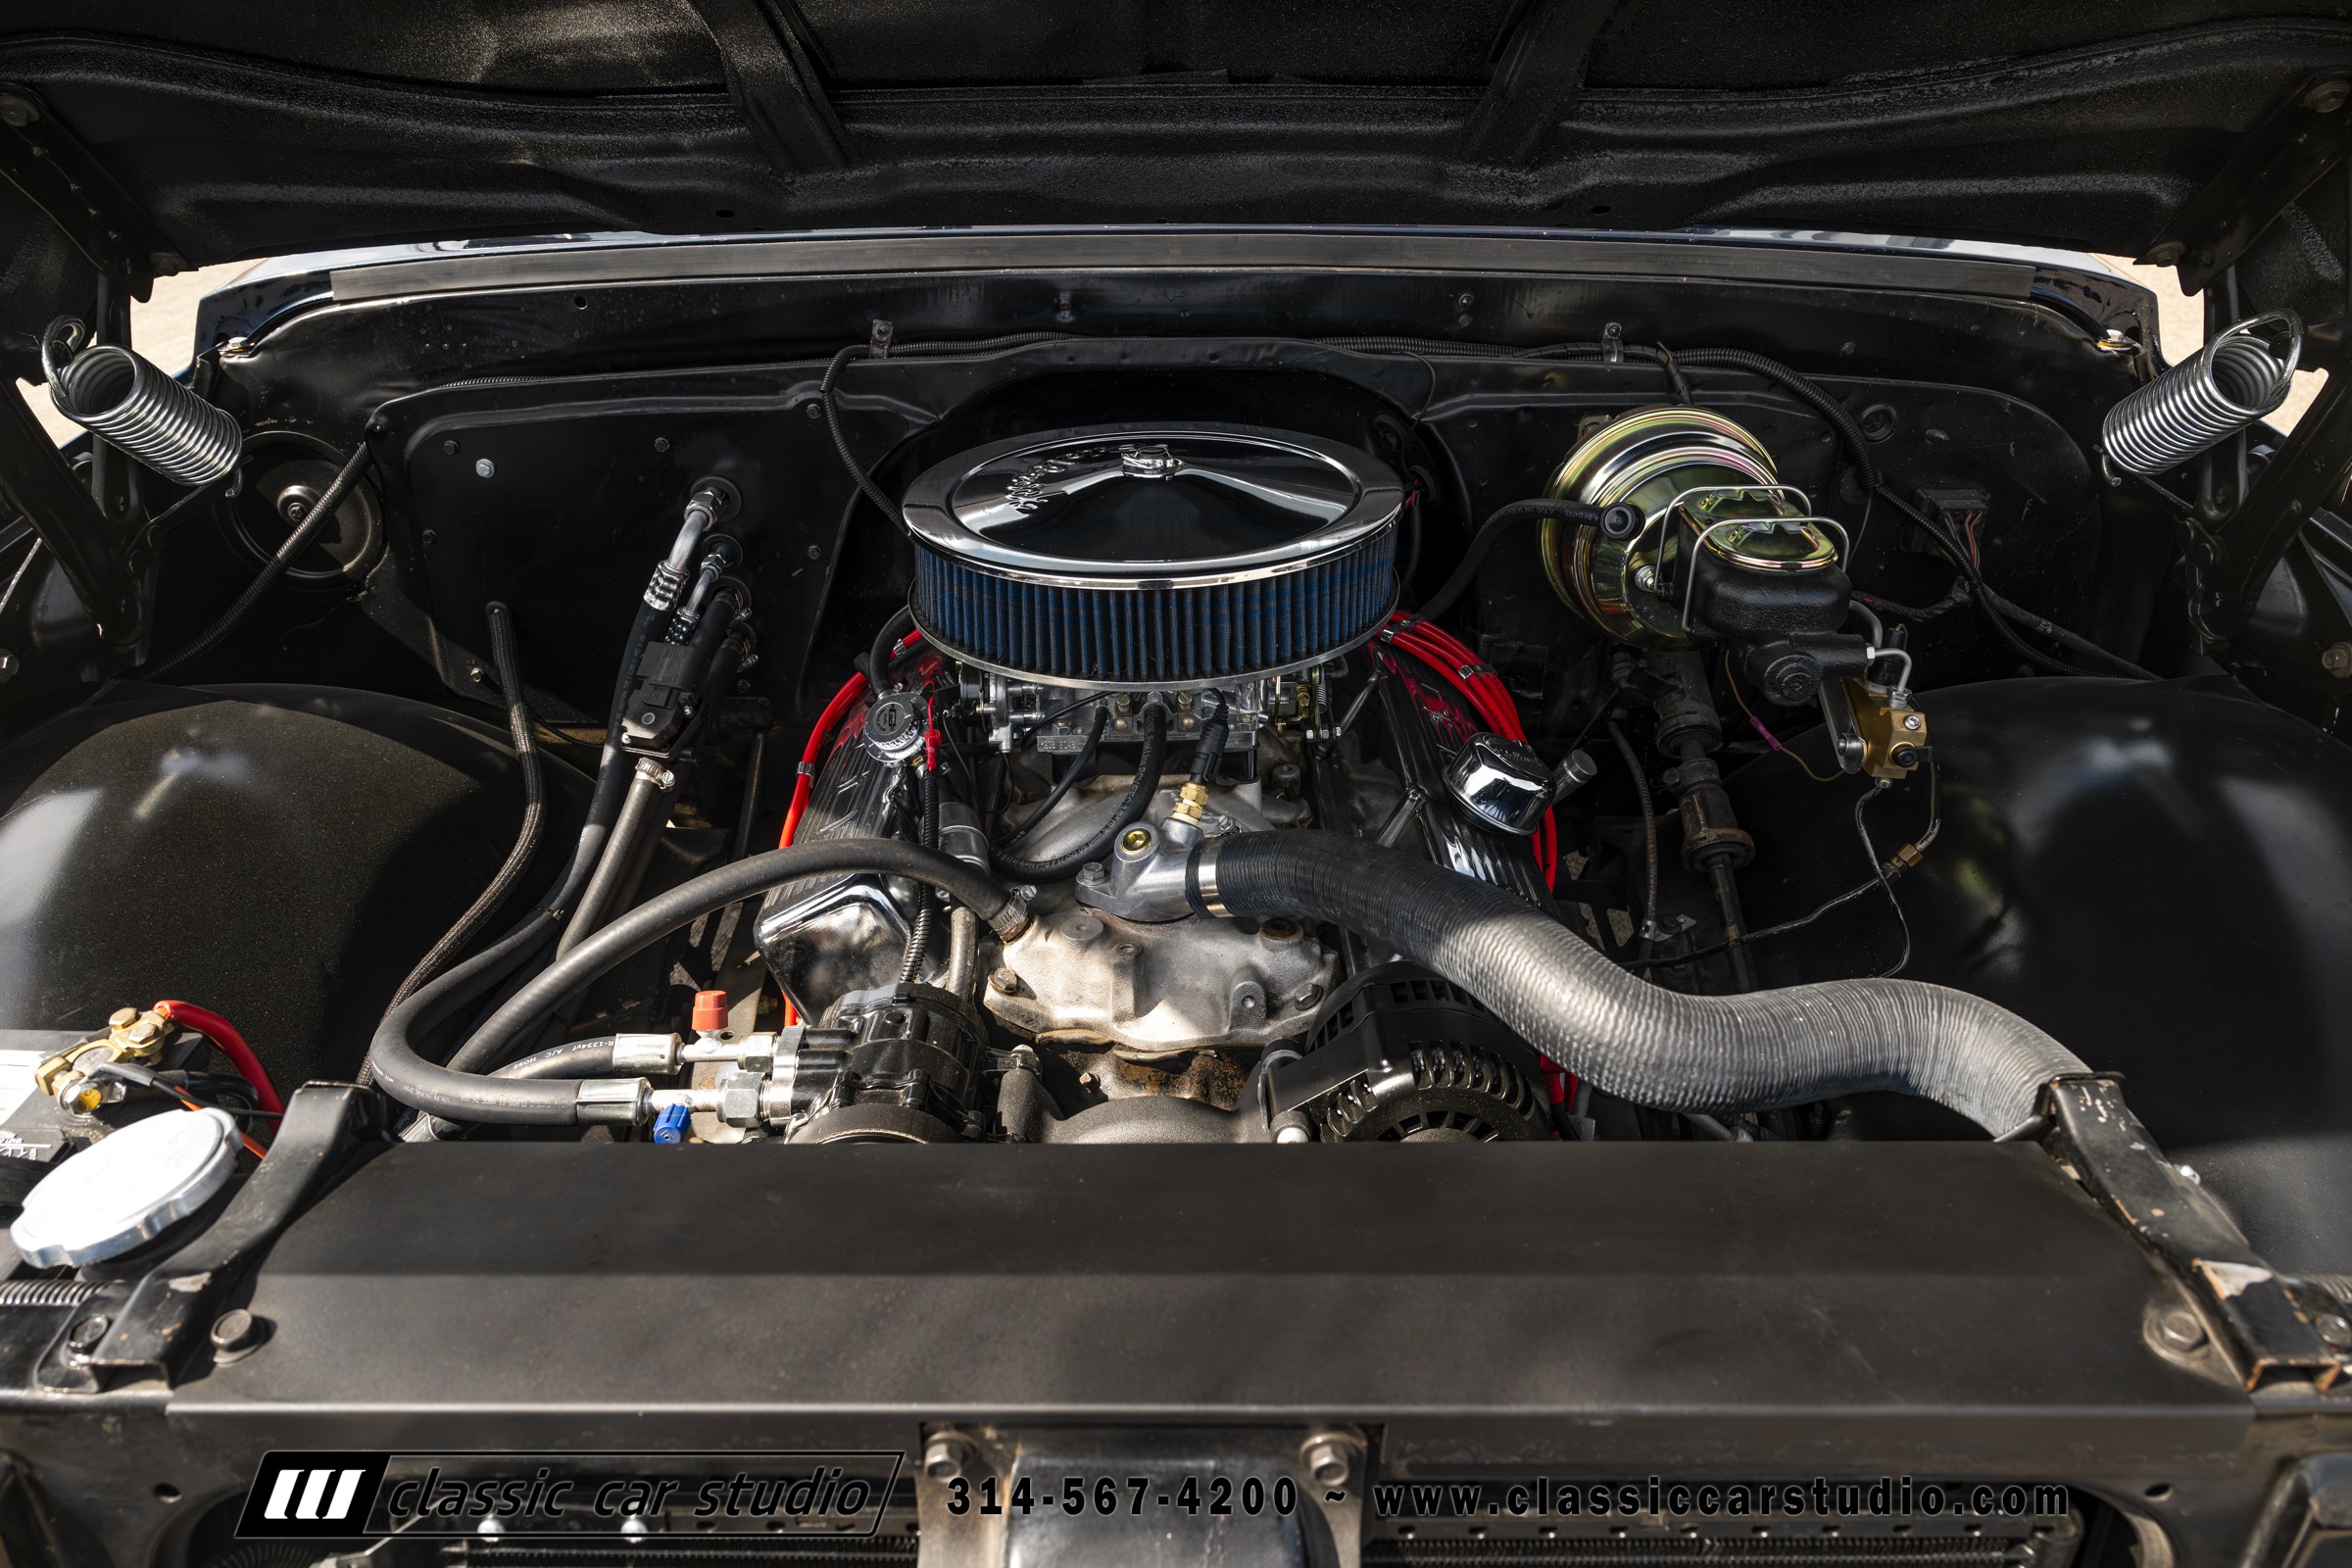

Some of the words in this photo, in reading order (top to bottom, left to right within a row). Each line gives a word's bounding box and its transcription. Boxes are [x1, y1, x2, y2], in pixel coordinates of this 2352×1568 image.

[1565, 509, 1584, 519] GATES
[571, 1040, 614, 1052] R-1234yf
[544, 1048, 564, 1058] A/C
[513, 1056, 537, 1070] HOSE
